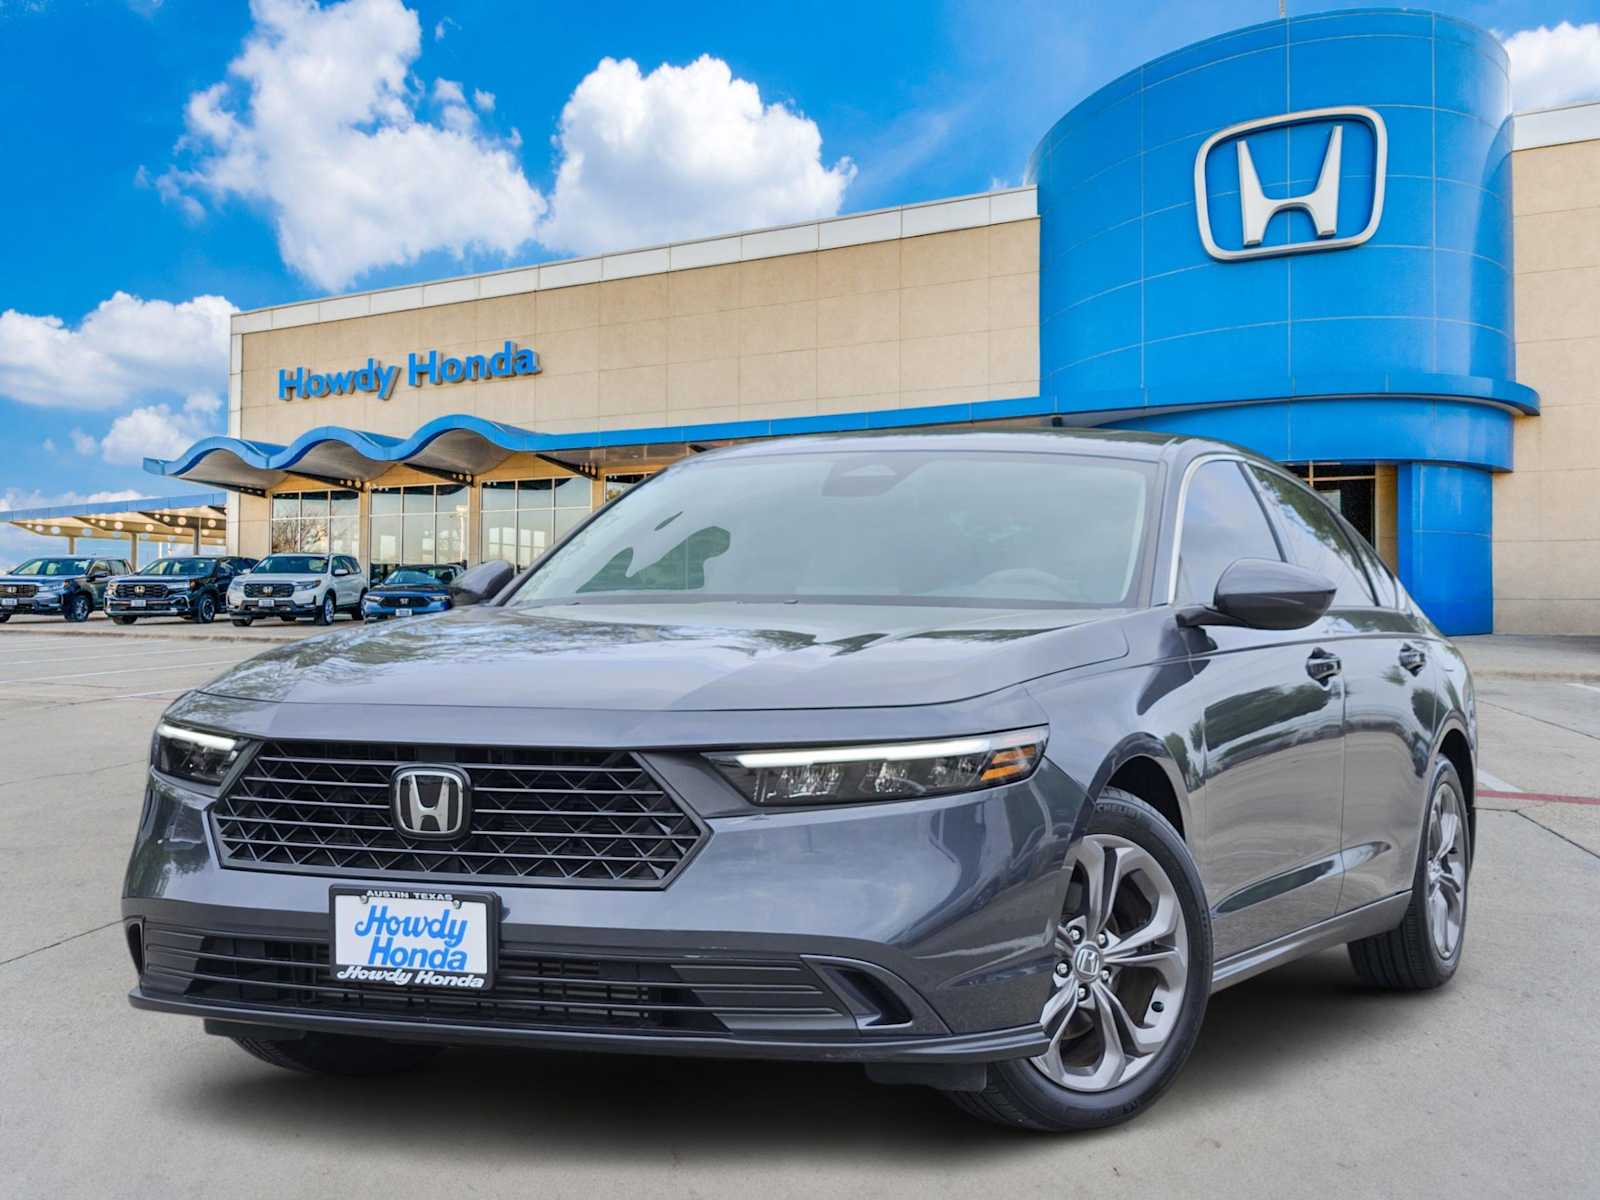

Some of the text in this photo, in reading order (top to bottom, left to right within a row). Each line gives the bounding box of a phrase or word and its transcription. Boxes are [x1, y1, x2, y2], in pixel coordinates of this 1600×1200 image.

[278, 340, 542, 401] Howdy Honda
[366, 890, 453, 900] AUSTIN TEXAS
[354, 905, 468, 948] Howdy
[368, 936, 468, 970] Honda
[336, 965, 485, 987] Howdy Honda
